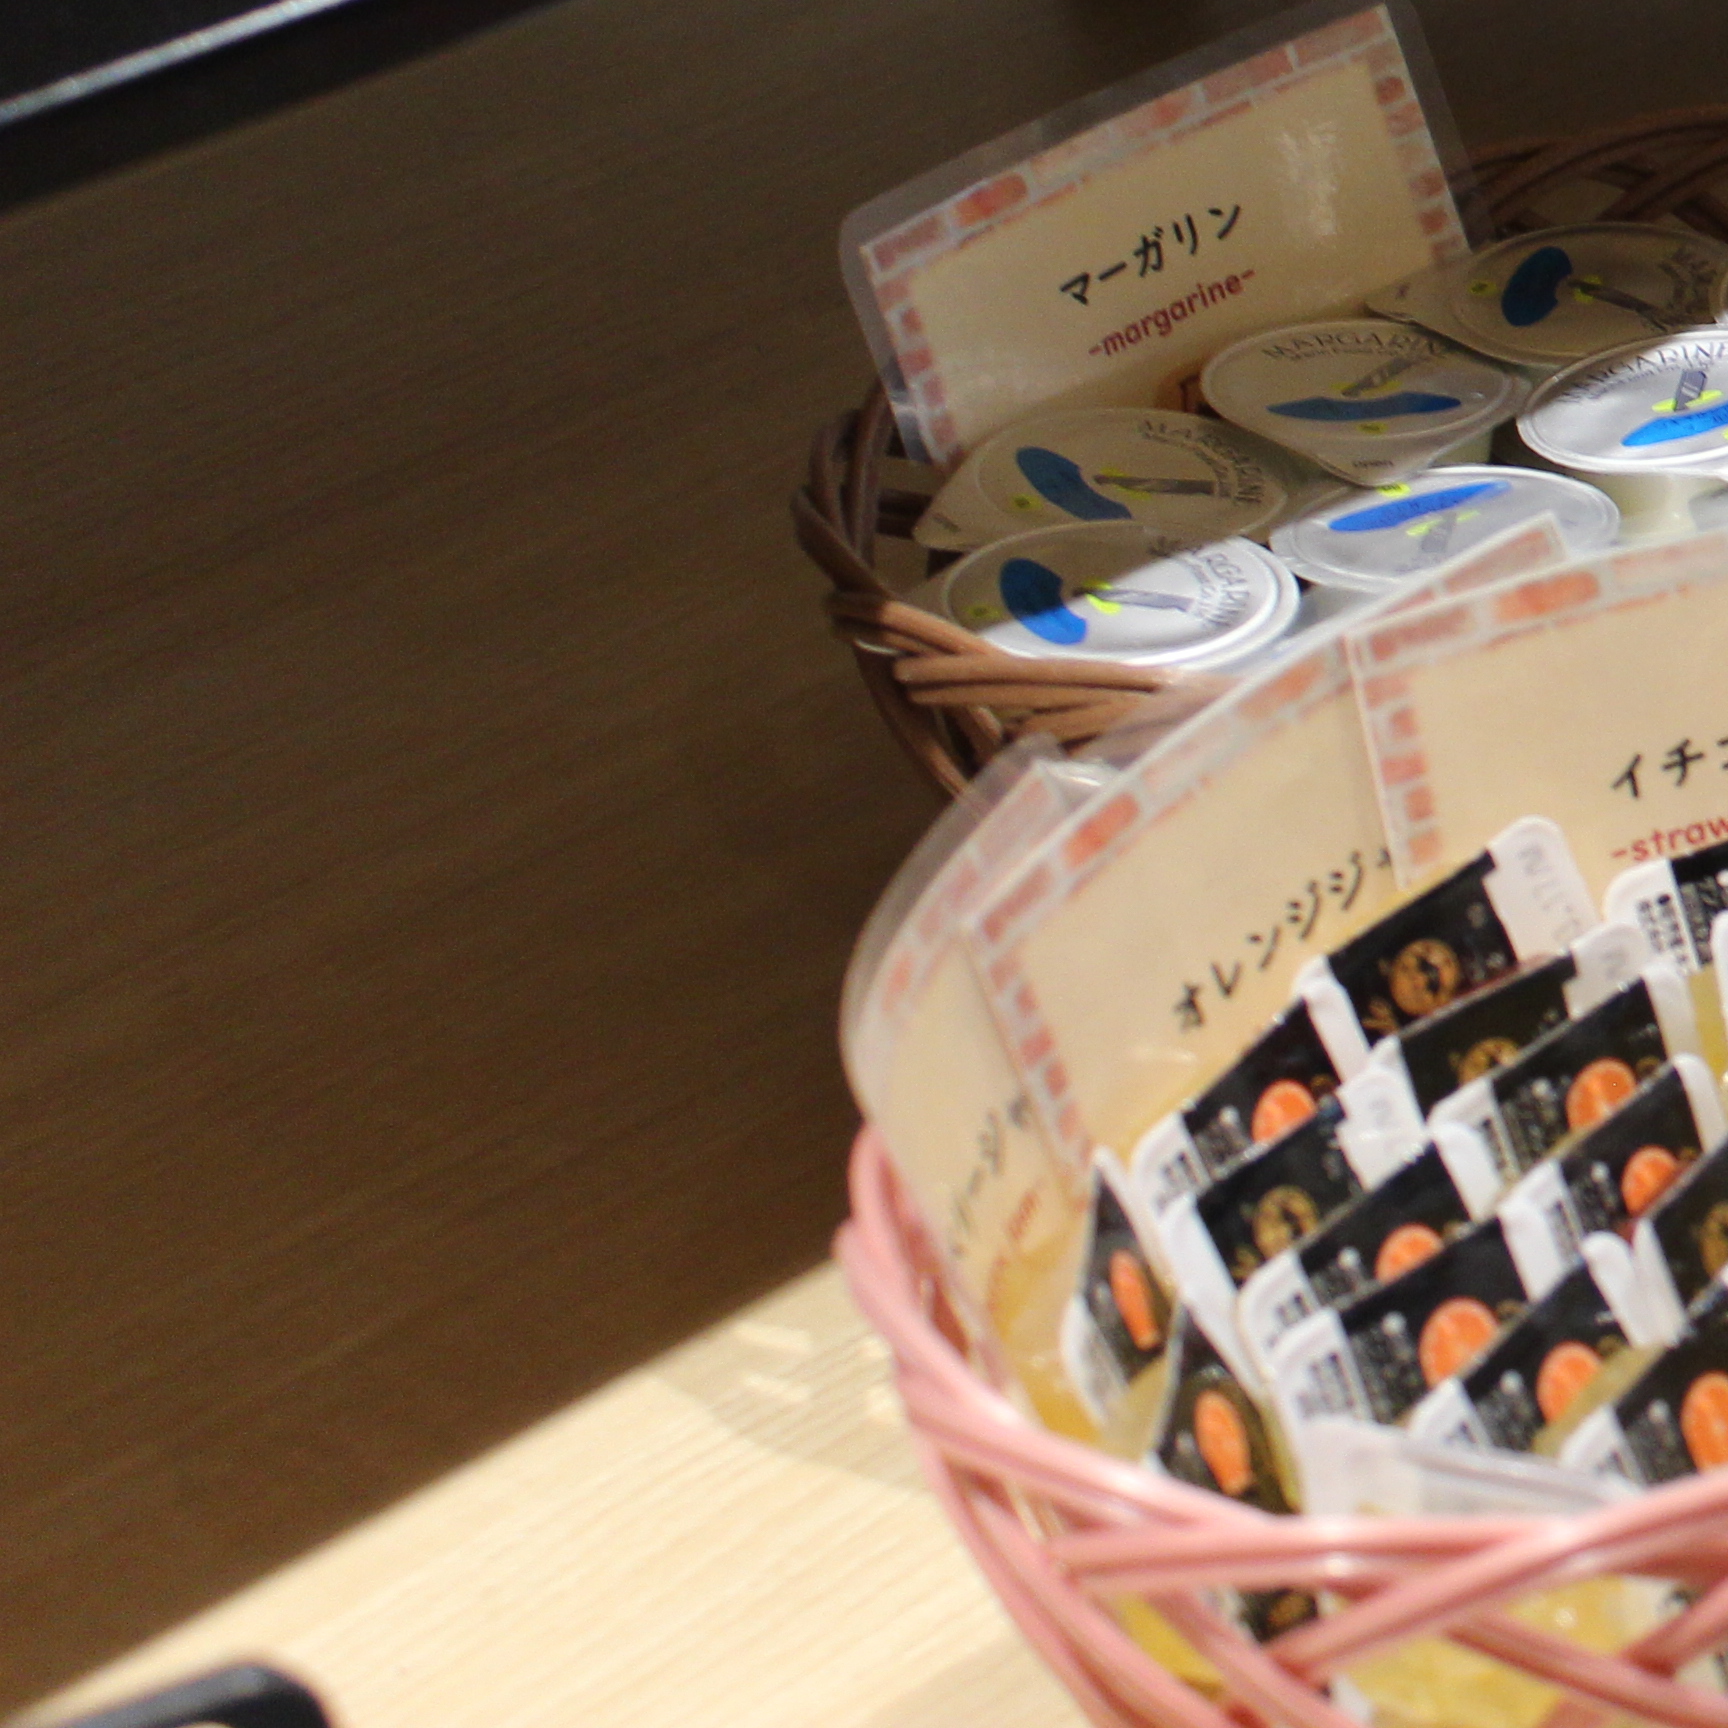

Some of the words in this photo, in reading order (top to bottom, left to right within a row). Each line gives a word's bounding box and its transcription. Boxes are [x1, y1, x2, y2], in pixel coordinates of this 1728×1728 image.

[1060, 203, 1242, 306] マーガリン
